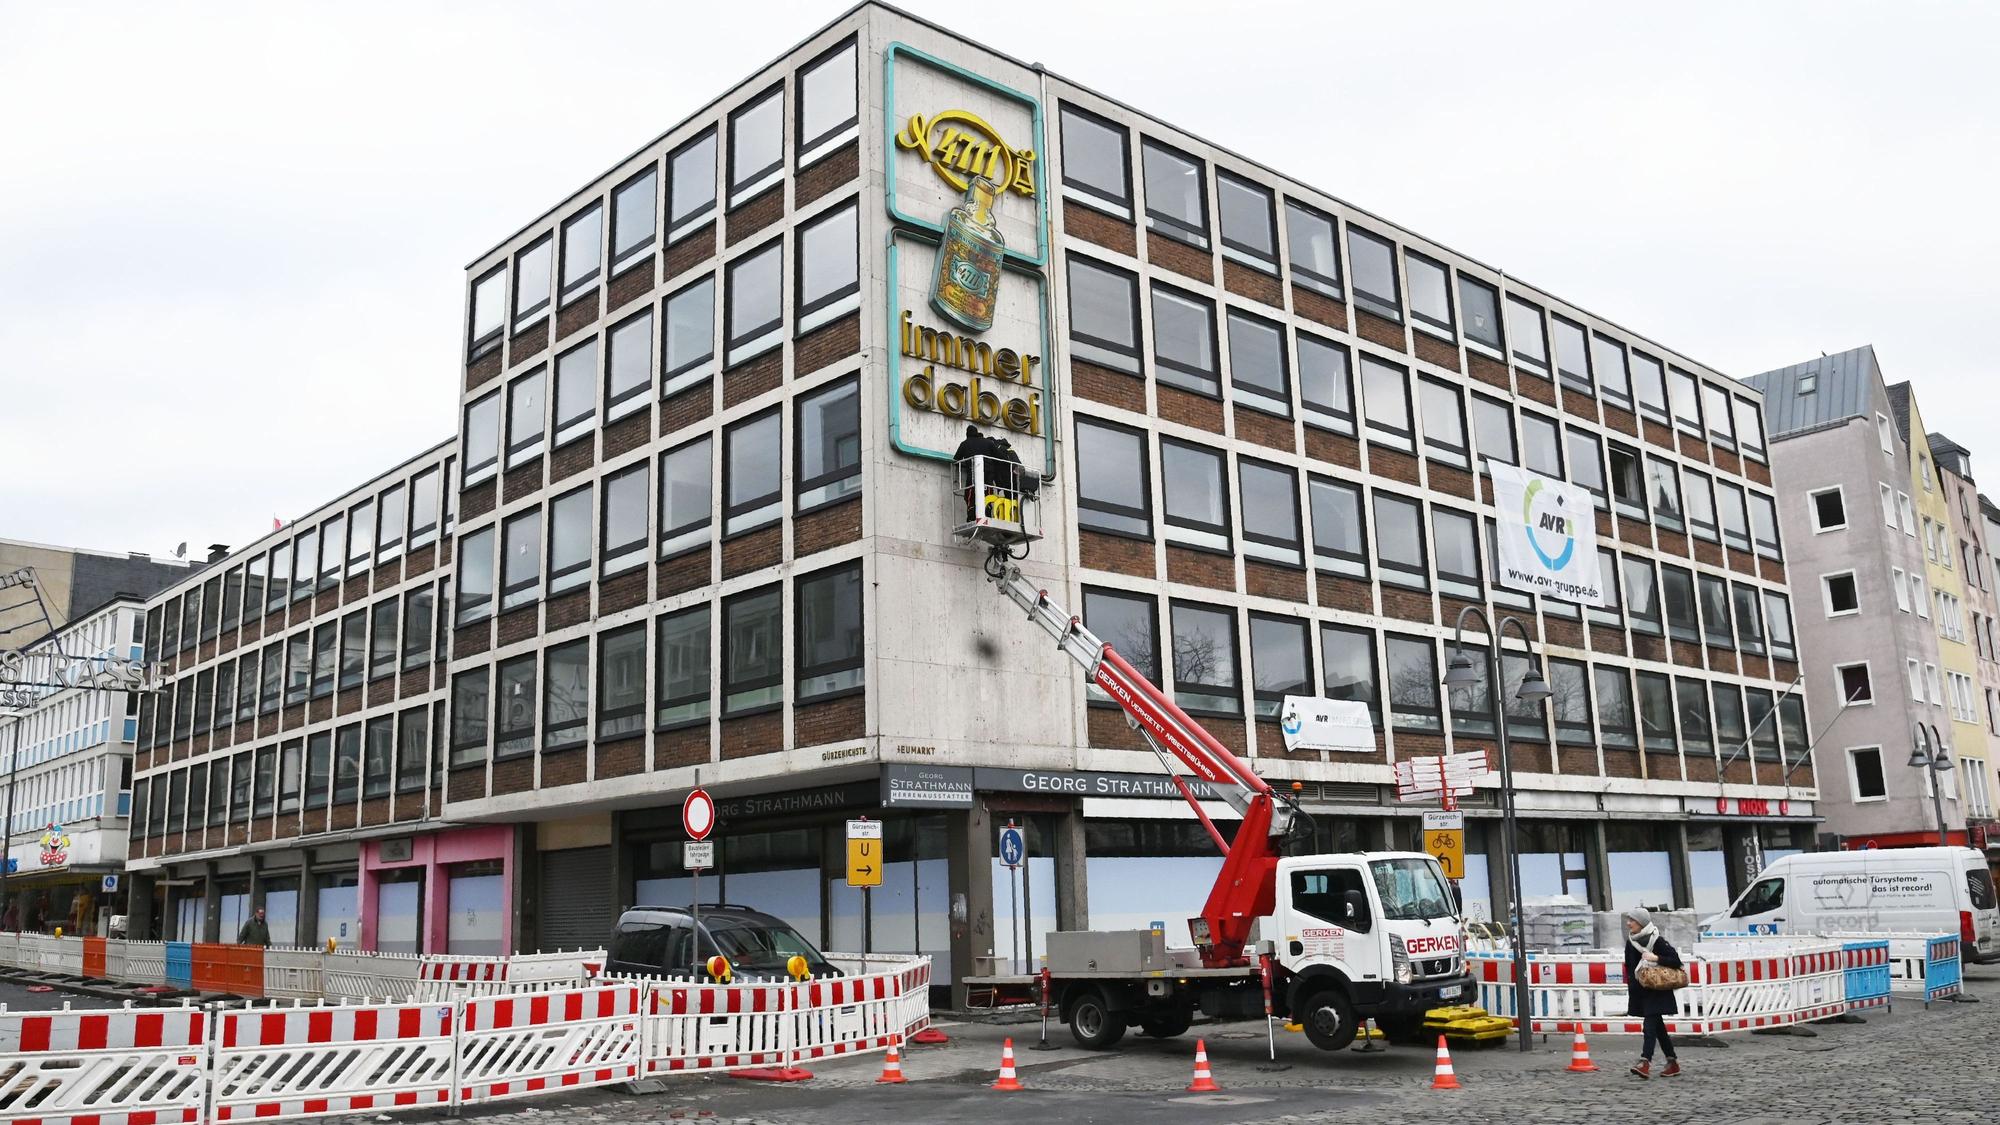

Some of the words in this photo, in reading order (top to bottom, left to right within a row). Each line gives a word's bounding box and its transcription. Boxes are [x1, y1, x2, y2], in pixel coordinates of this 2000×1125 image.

[935, 127, 1002, 180] 4711
[901, 310, 1041, 385] immer
[904, 365, 1041, 435] dabei
[1540, 512, 1565, 535] AVR
[1508, 568, 1599, 598] www.avr-gruppe.de
[1098, 669, 1132, 703] GERKEN
[1130, 700, 1165, 735] VERMIETET
[1164, 732, 1217, 781] ARBEITSBÜHNEN
[890, 778, 972, 792] STRATHMANN
[1022, 772, 1088, 792] GEORG
[1096, 776, 1212, 797] STRATHMNN
[745, 791, 845, 815] STRATHMANN
[1738, 798, 1769, 816] KIOSK
[860, 842, 870, 857] U
[1813, 876, 1867, 886] automatische
[1870, 875, 1918, 885] Türsysteme
[1871, 885, 1884, 893] das
[1889, 884, 1899, 892] ist
[1901, 883, 1933, 892] record!
[1815, 909, 1880, 929] record
[1302, 929, 1345, 938] GERKEN
[1406, 935, 1460, 954] GERKEN
